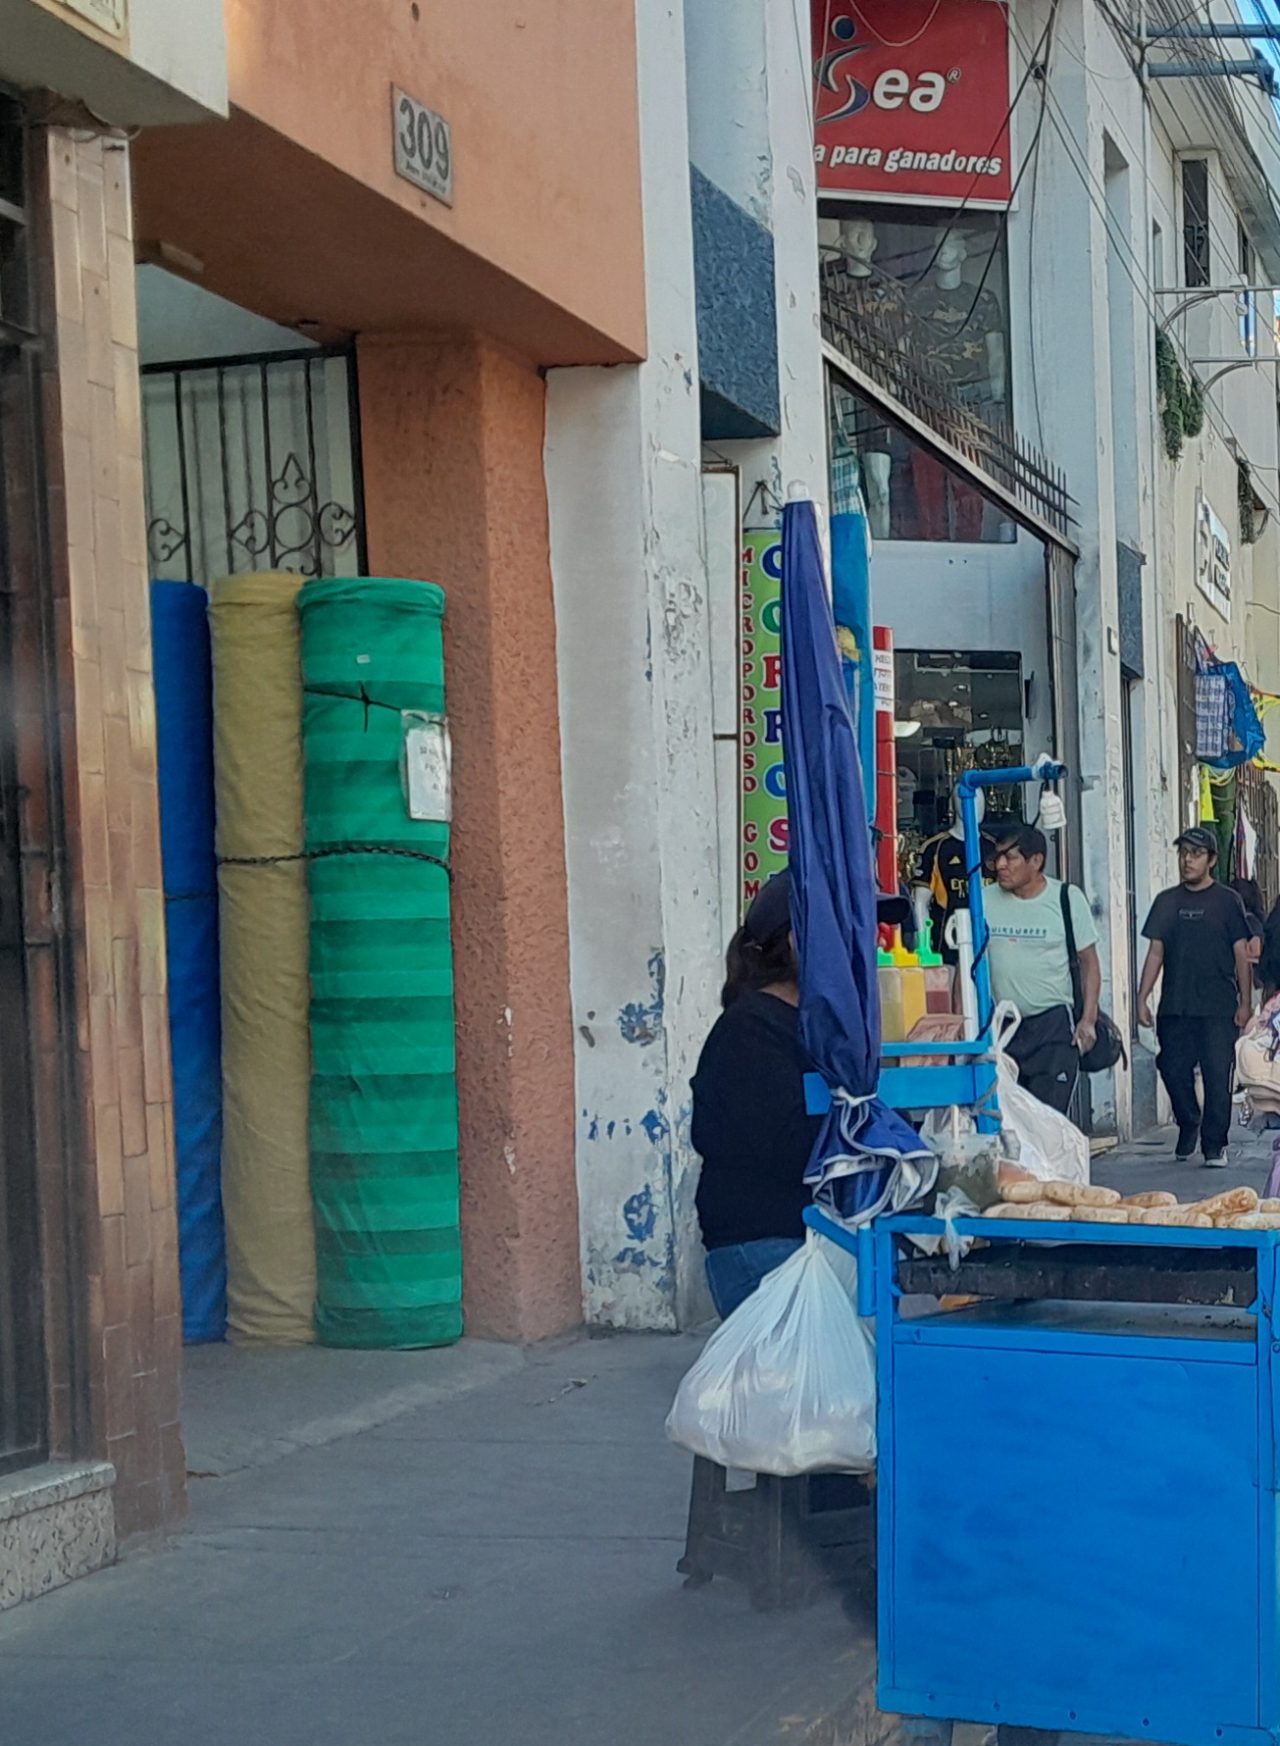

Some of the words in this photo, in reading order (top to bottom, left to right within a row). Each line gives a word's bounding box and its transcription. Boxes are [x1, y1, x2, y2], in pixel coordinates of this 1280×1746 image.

[400, 98, 449, 181] 309
[829, 145, 882, 168] para
[884, 147, 1002, 176] ganadores
